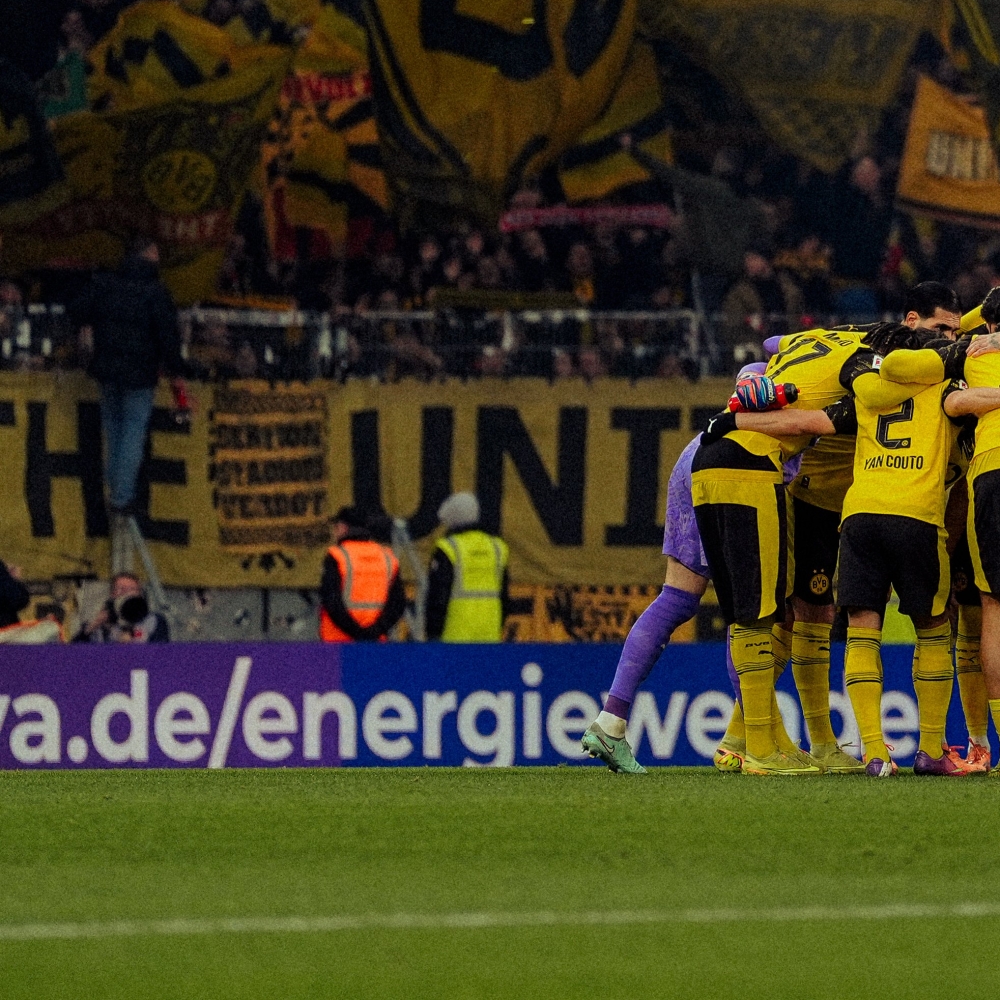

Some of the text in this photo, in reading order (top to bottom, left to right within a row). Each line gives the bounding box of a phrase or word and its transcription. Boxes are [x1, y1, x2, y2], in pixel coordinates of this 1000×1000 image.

[875, 398, 914, 449] 2
[863, 453, 924, 471] YAN COUTO
[812, 576, 828, 590] BVB
